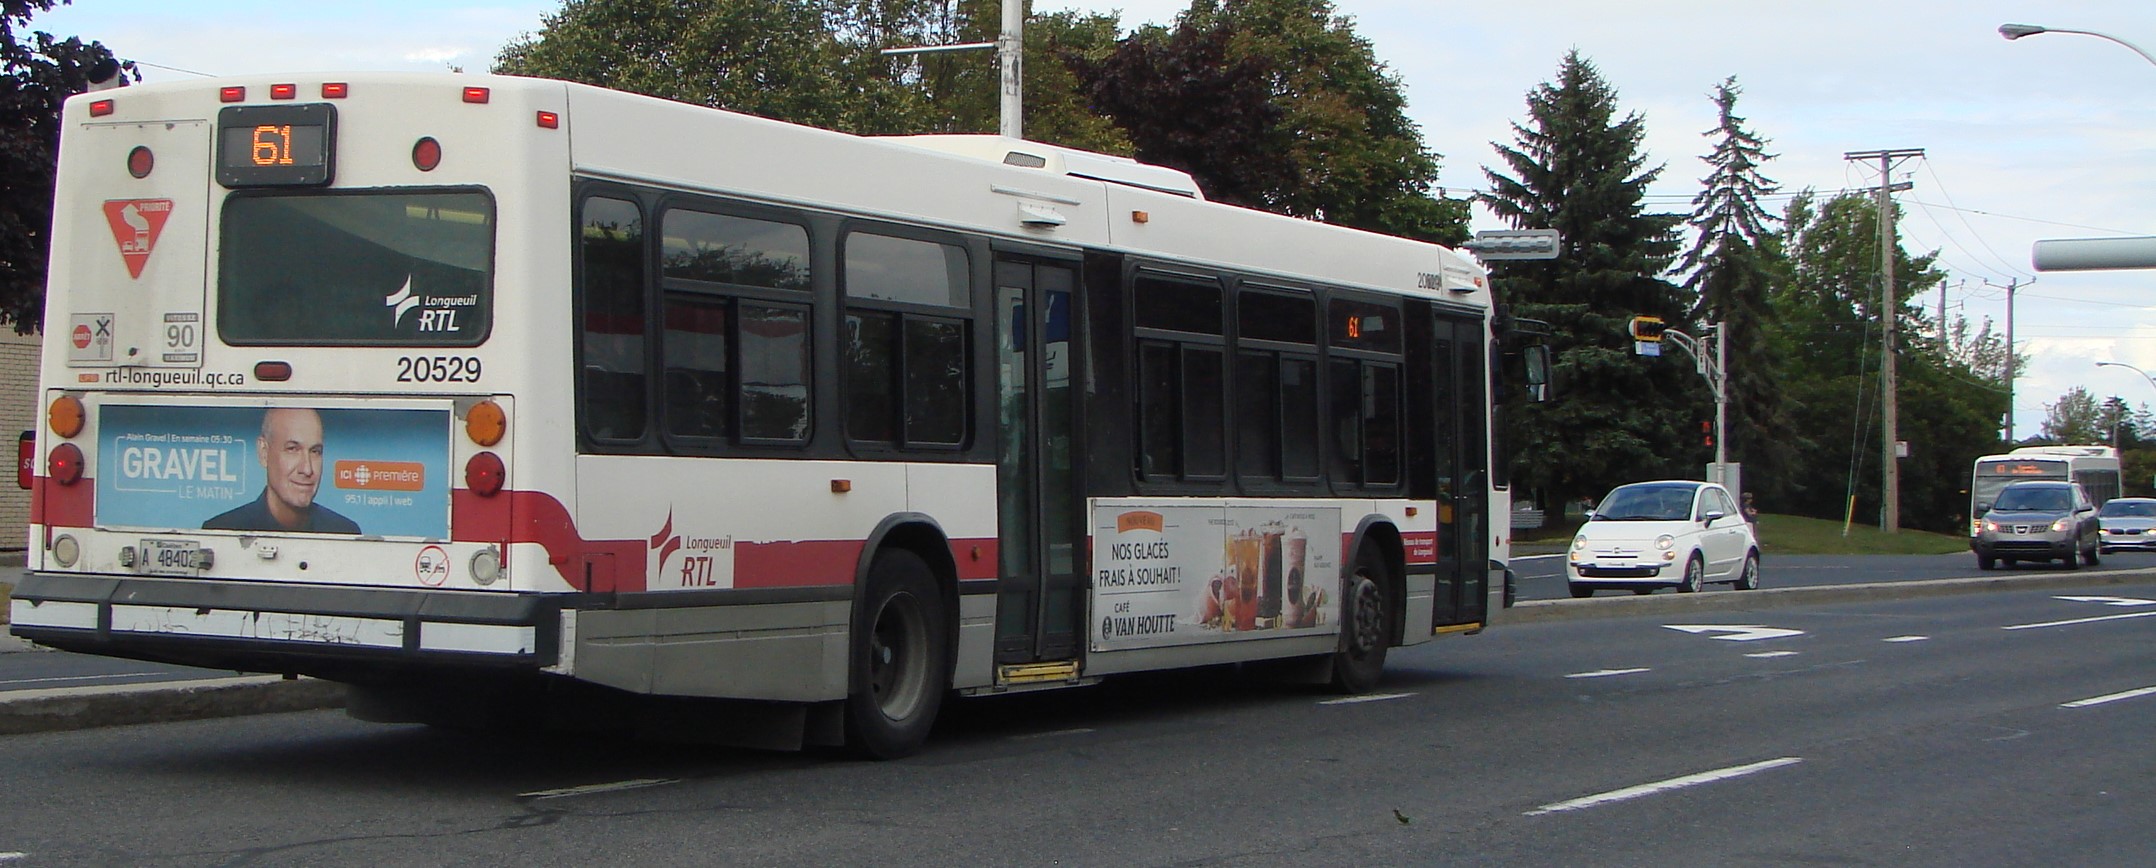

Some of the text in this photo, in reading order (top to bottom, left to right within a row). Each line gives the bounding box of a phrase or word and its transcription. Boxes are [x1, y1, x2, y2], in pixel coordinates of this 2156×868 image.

[253, 125, 293, 165] 61
[425, 294, 477, 309] Longueuil
[418, 309, 460, 332] RTL
[1349, 316, 1359, 338] 61
[167, 324, 194, 348] 90
[105, 367, 245, 388] rtl-longueuil.qc.ca
[396, 356, 482, 383] 20529
[126, 433, 144, 441] Alain
[171, 435, 180, 443] En
[123, 447, 237, 482] GRAVEL
[340, 470, 352, 480] ICI
[179, 486, 233, 500] LE MATIN
[394, 497, 413, 506] web
[686, 534, 731, 553] Longueuil
[1111, 537, 1169, 561] NOS GLACÉS
[141, 548, 149, 566] A
[680, 556, 717, 587] RTL
[1099, 569, 1126, 587] FRAIS
[1128, 564, 1135, 586] À
[1137, 567, 1177, 586] SOUHAIT
[1114, 600, 1130, 613] CAFÉ
[1114, 614, 1176, 637] VAN HOUTTE
